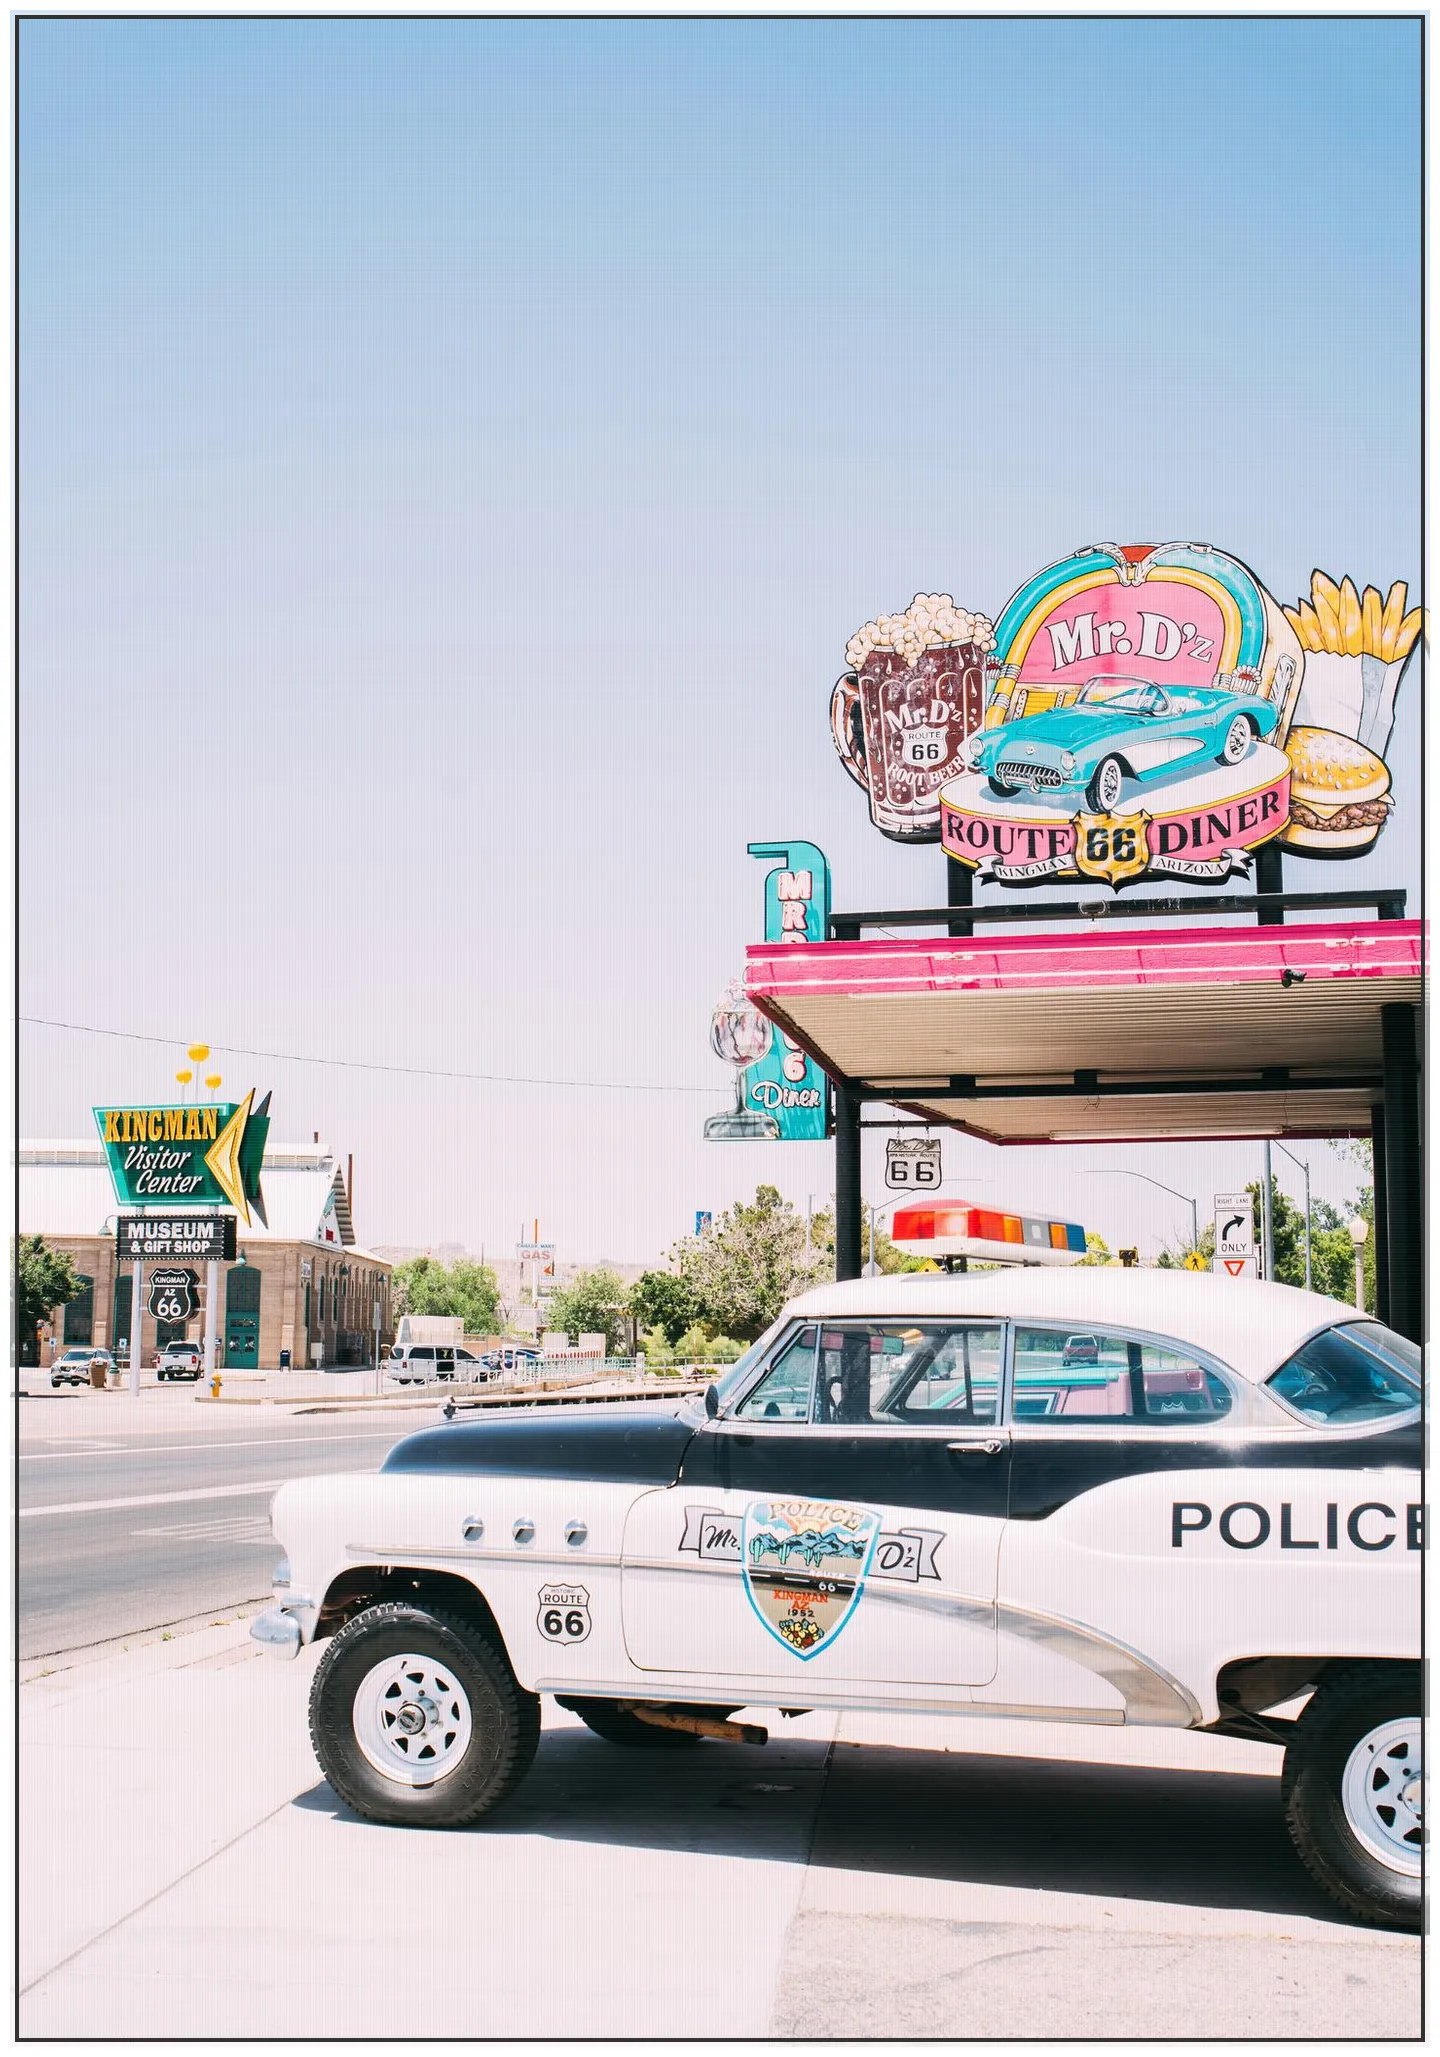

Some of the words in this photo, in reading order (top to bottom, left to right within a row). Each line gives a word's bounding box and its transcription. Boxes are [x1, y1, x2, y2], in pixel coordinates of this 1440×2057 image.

[1045, 608, 1132, 671] Mr.
[884, 702, 928, 734] Mr.
[908, 731, 941, 740] ROUTE
[912, 743, 939, 760] 66
[887, 761, 926, 786] ROOT
[928, 755, 966, 786] BEER
[946, 811, 1072, 859] ROUTE
[1086, 827, 1136, 862] 66
[1158, 790, 1280, 854] DINER
[997, 856, 1070, 879] KINGMAN
[1155, 858, 1225, 875] ARIZONA
[751, 1080, 821, 1109] Diner
[104, 1108, 219, 1143] KINGMAN
[123, 1144, 193, 1170] Visitor
[891, 1160, 934, 1181] 66
[136, 1169, 204, 1195] Center
[128, 1222, 214, 1239] MUSEUM
[130, 1240, 141, 1253] &
[144, 1240, 172, 1253] GIFT
[173, 1240, 211, 1253] SHOP
[521, 1249, 551, 1260] GAS
[1221, 1243, 1247, 1252] ONLY
[155, 1276, 185, 1284] KINGMAN
[164, 1288, 176, 1296] AZ
[157, 1297, 182, 1317] 66
[769, 1501, 866, 1532] POLICE
[705, 1525, 741, 1551] Mr.
[773, 1589, 829, 1603] KINGMAN
[819, 1581, 836, 1592] 66
[544, 1594, 583, 1604] ROUTE
[791, 1601, 811, 1610] AZ
[544, 1609, 584, 1637] 66
[788, 1609, 815, 1617] 1952
